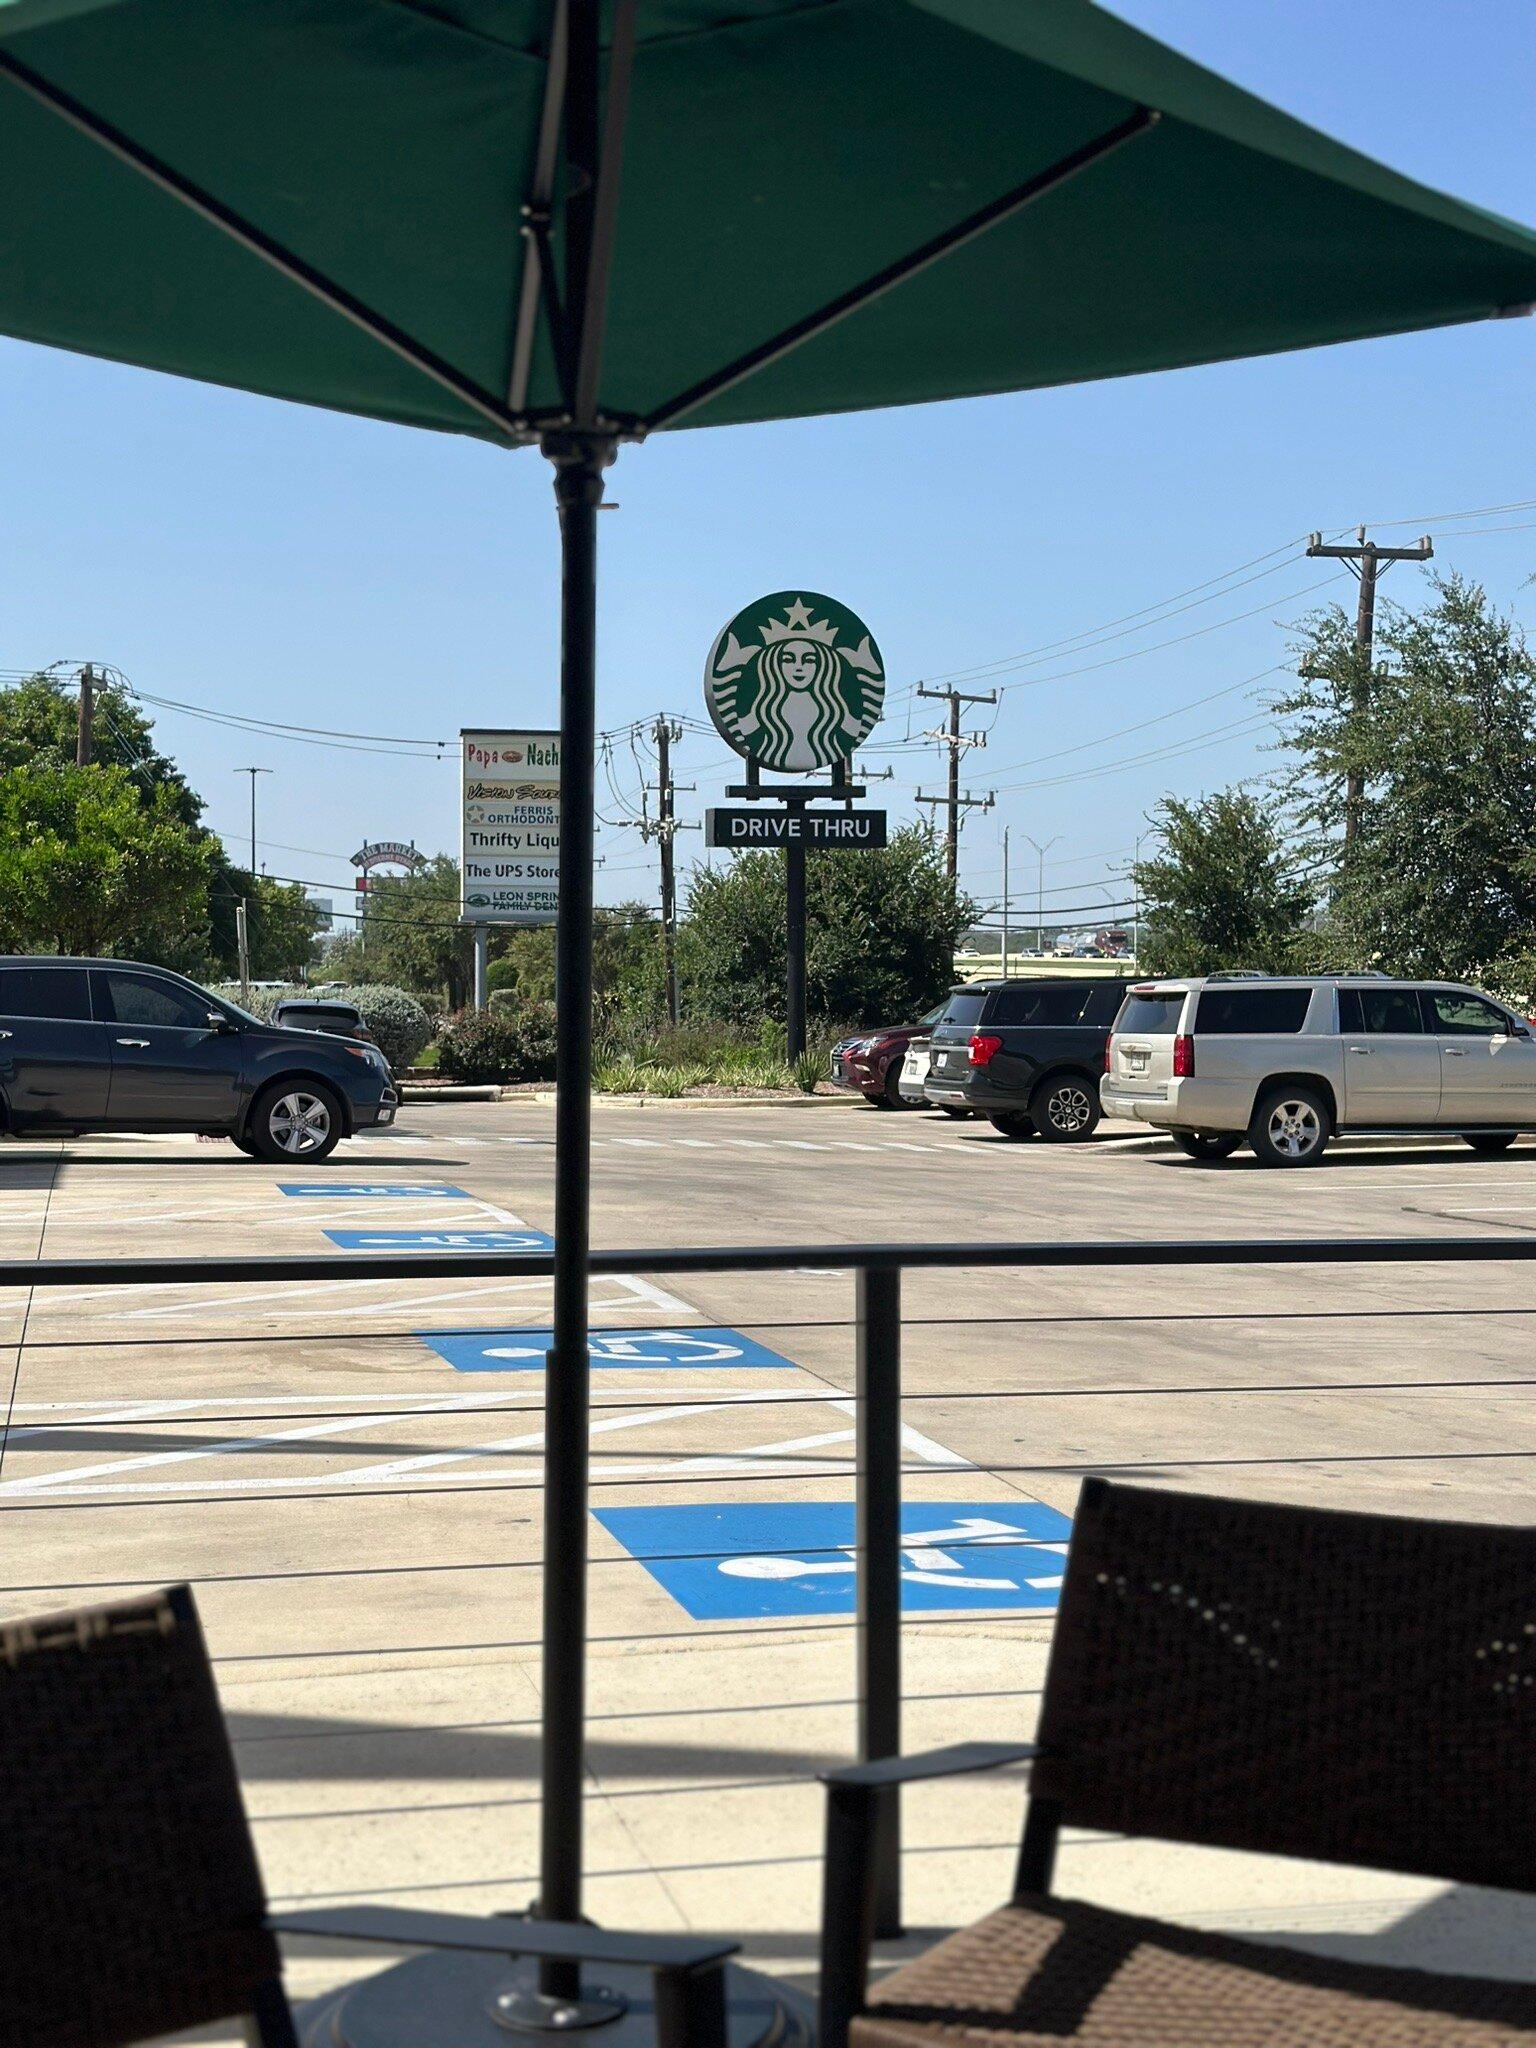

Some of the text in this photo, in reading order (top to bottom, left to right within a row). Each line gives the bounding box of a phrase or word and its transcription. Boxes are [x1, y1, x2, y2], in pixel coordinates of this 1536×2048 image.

[468, 742, 559, 769] Papa Nach
[514, 806, 553, 815] FERRIS
[488, 814, 560, 824] ORTHODONT
[731, 818, 870, 838] DRIVE THRU
[470, 832, 559, 849] Thrifty Liqu
[359, 843, 420, 860] THE MARKET
[466, 864, 560, 878] The UPS Store
[493, 891, 559, 901] LEON SPRIN
[493, 901, 558, 911] FAMILY DEN
